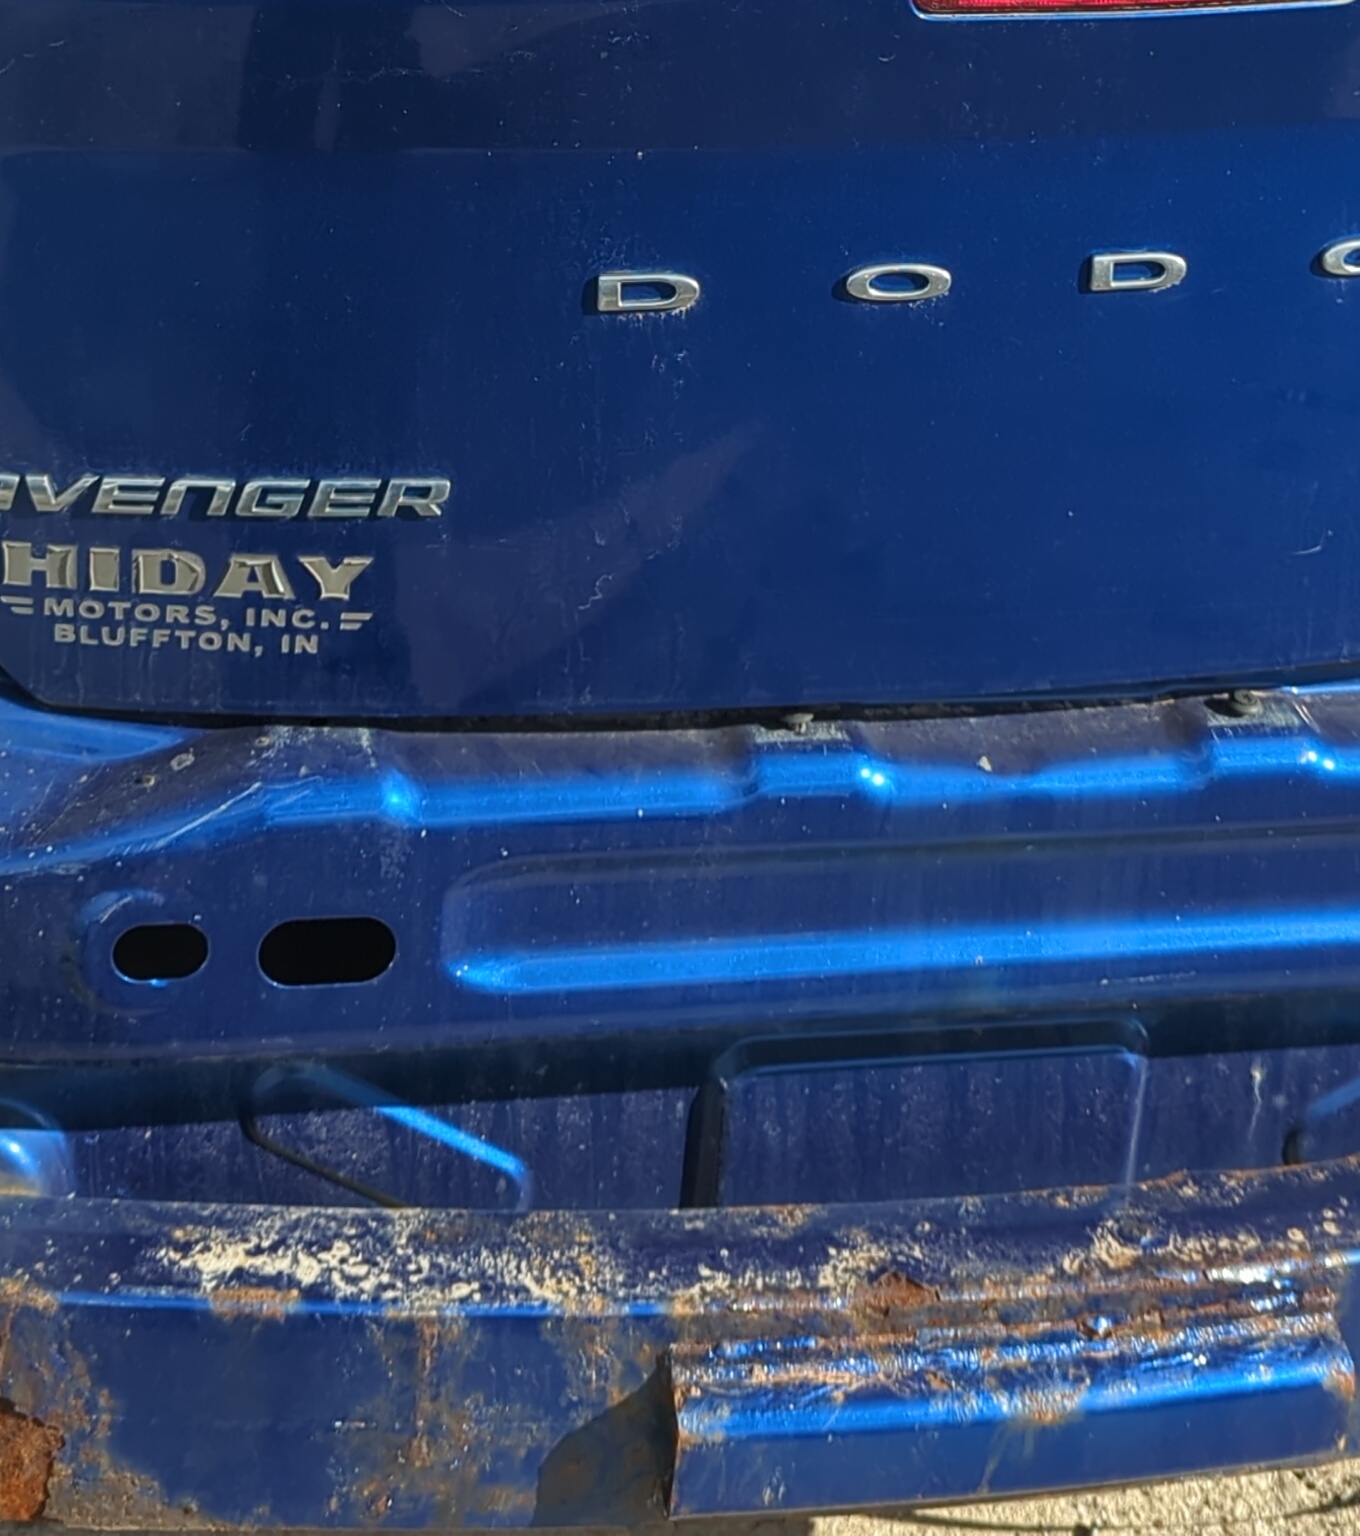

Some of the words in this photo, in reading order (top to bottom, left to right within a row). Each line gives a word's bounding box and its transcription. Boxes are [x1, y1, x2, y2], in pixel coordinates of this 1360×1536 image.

[1, 541, 374, 601] HIDAY
[43, 597, 230, 632] MOTORS,
[246, 607, 330, 631] INC.
[53, 623, 263, 658] BLUFFTON,
[281, 634, 319, 655] IN
